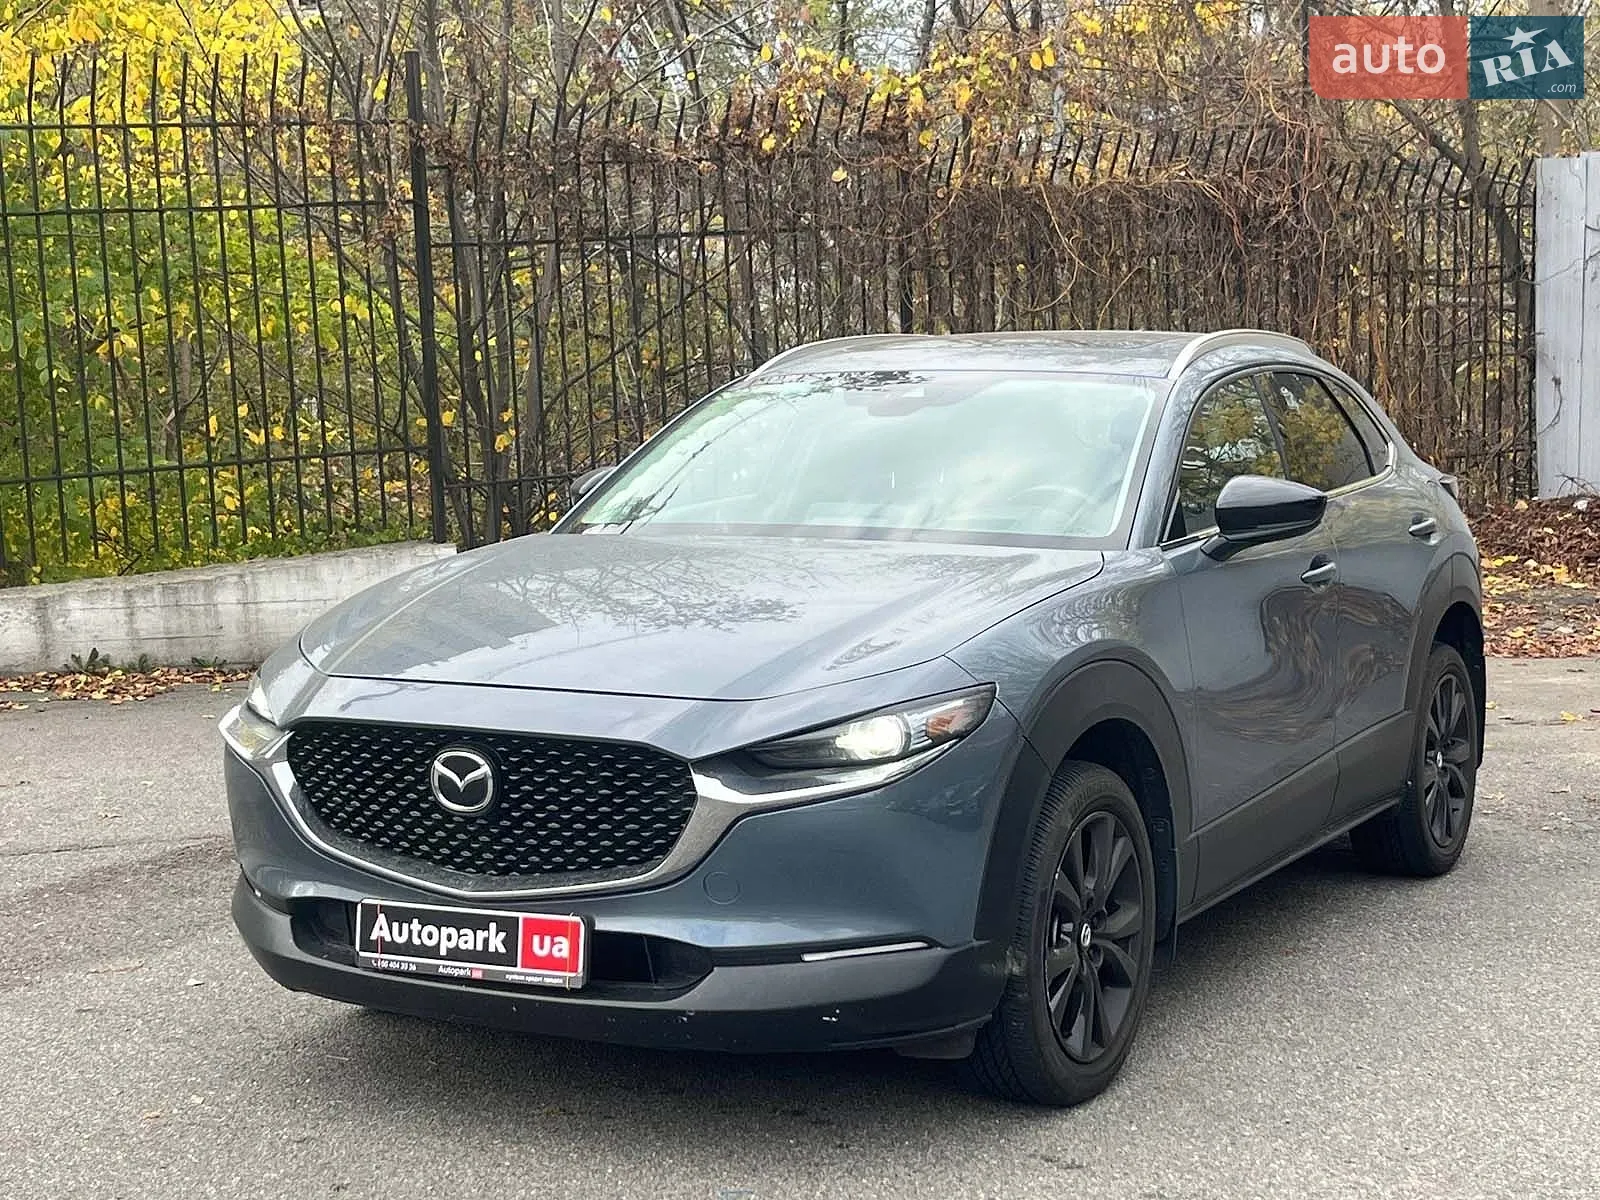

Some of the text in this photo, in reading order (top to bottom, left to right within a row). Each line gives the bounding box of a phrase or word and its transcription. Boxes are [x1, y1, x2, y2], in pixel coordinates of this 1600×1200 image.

[370, 912, 569, 959] Autopark ua
[438, 965, 471, 977] Autopark
